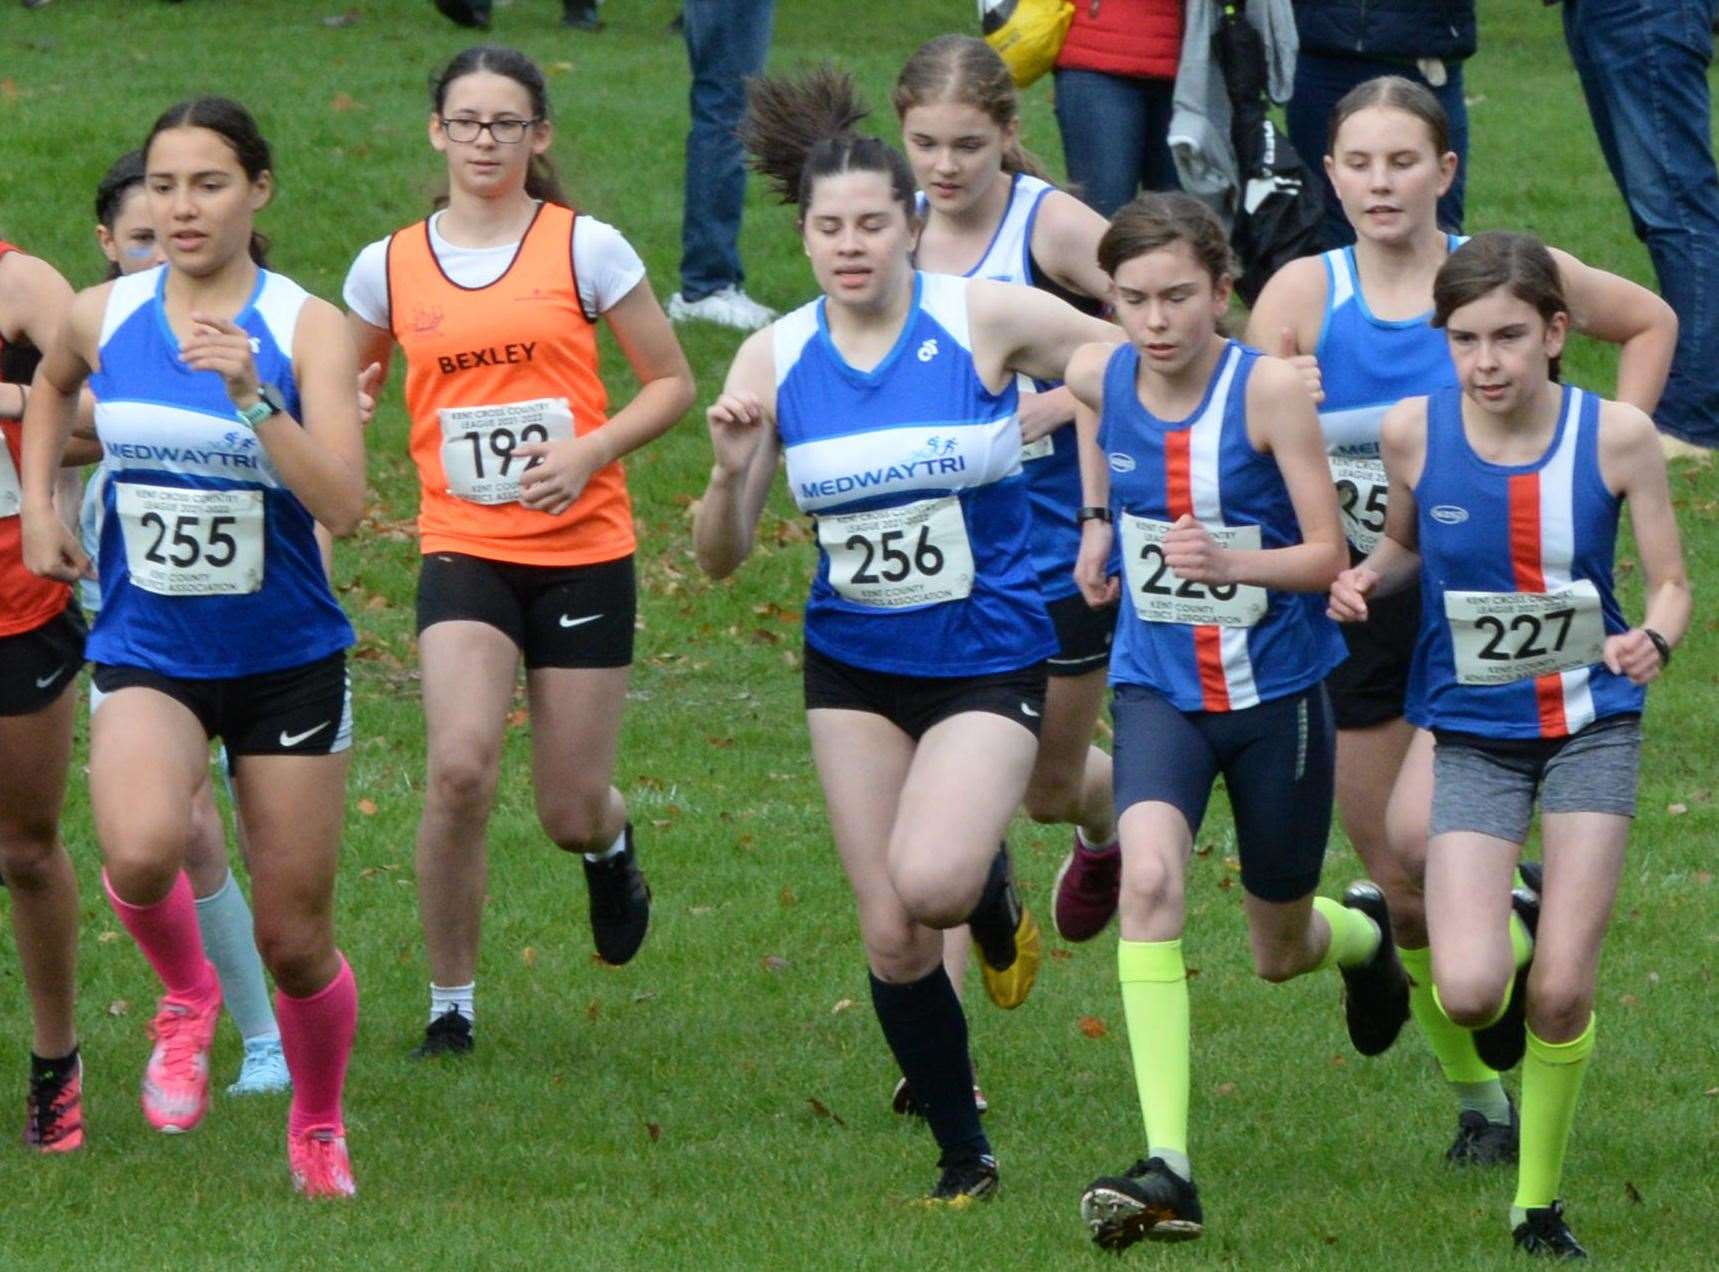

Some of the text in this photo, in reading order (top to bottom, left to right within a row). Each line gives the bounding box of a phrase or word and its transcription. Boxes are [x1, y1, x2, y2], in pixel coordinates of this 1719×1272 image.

[438, 342, 537, 375] BEXLEY
[452, 409, 473, 420] KENT
[106, 443, 257, 470] MEDWAYTRI
[801, 456, 966, 498] MEDWAYTRI
[141, 512, 237, 568] 255
[846, 525, 944, 584] 256
[1474, 608, 1576, 661] 227
